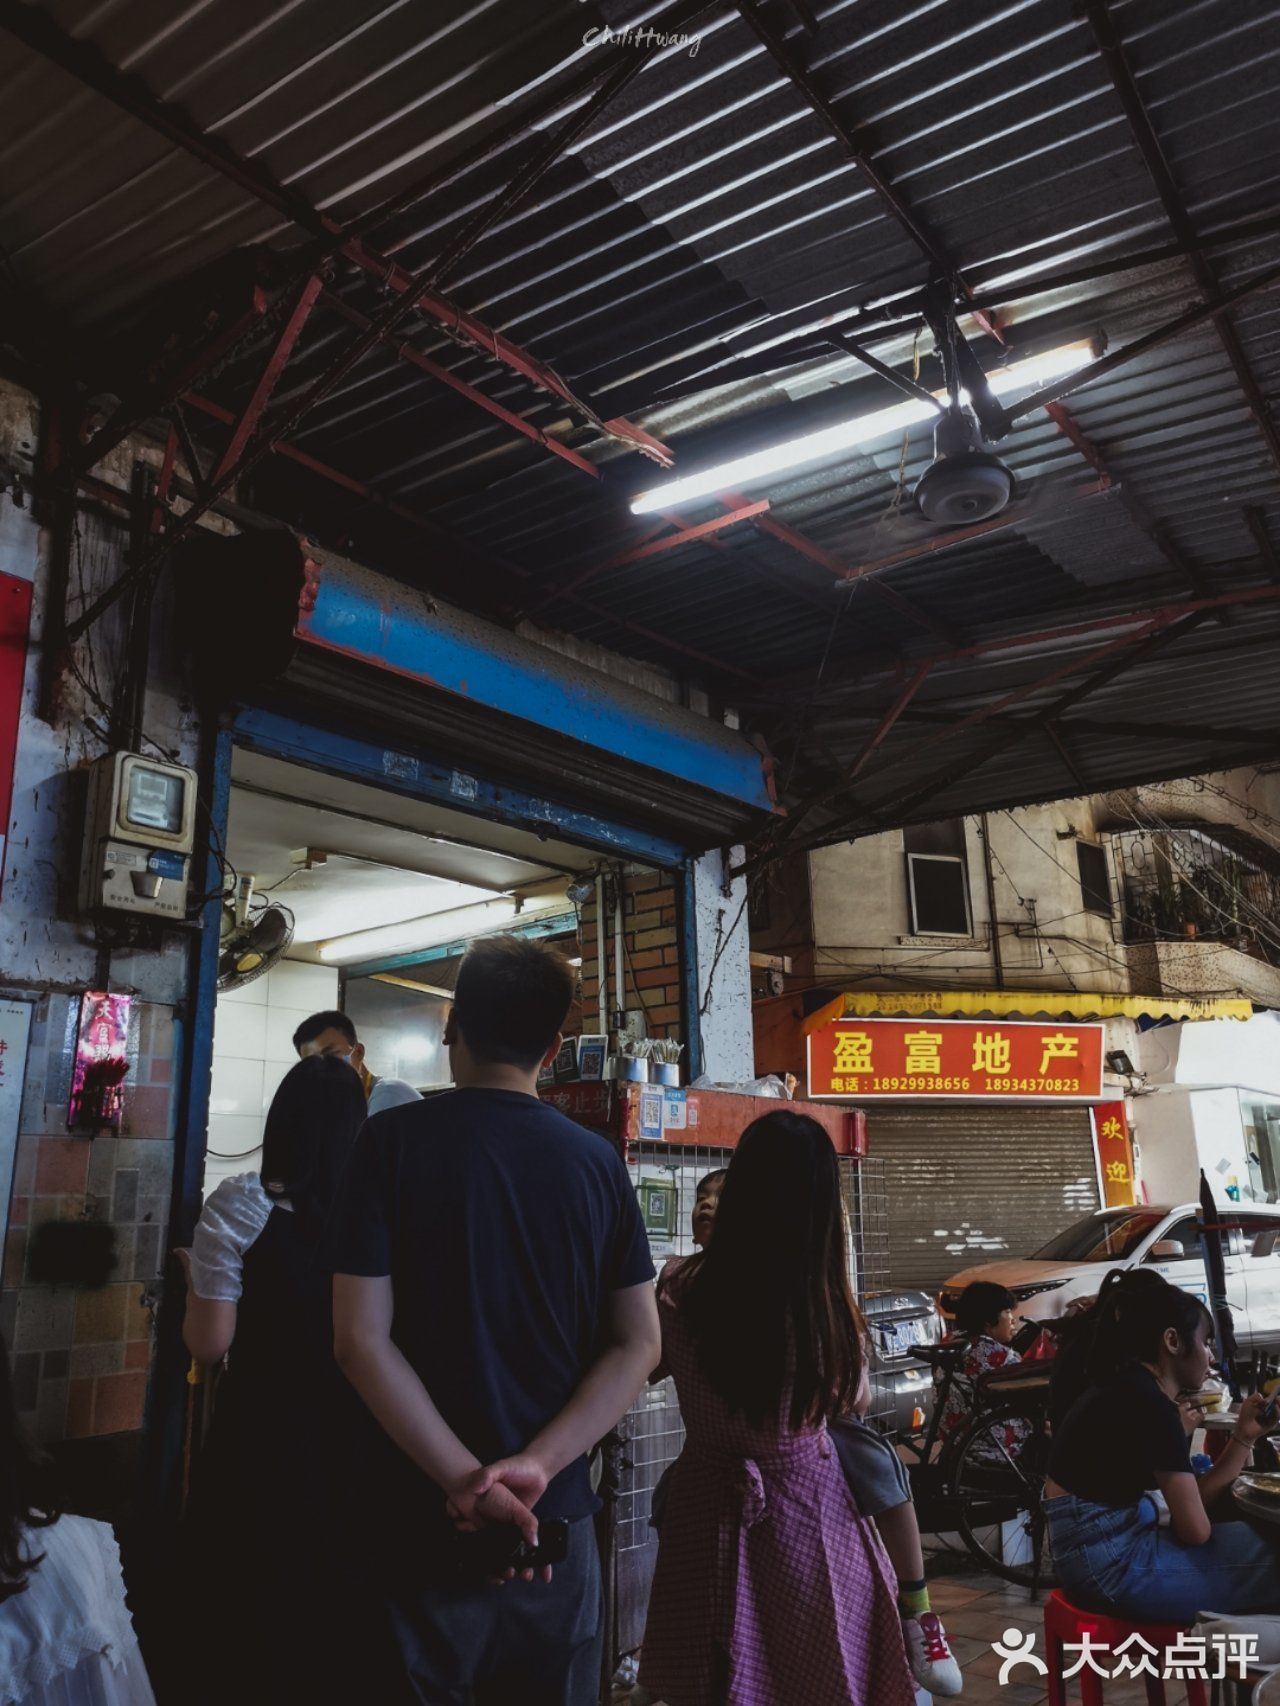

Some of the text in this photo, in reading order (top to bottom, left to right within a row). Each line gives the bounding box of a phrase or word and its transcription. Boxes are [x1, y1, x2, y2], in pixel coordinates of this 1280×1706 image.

[832, 1030, 1079, 1075] 盈富地产
[984, 1078, 1079, 1092] 18934370823
[1101, 1116, 1130, 1184] 欢迎
